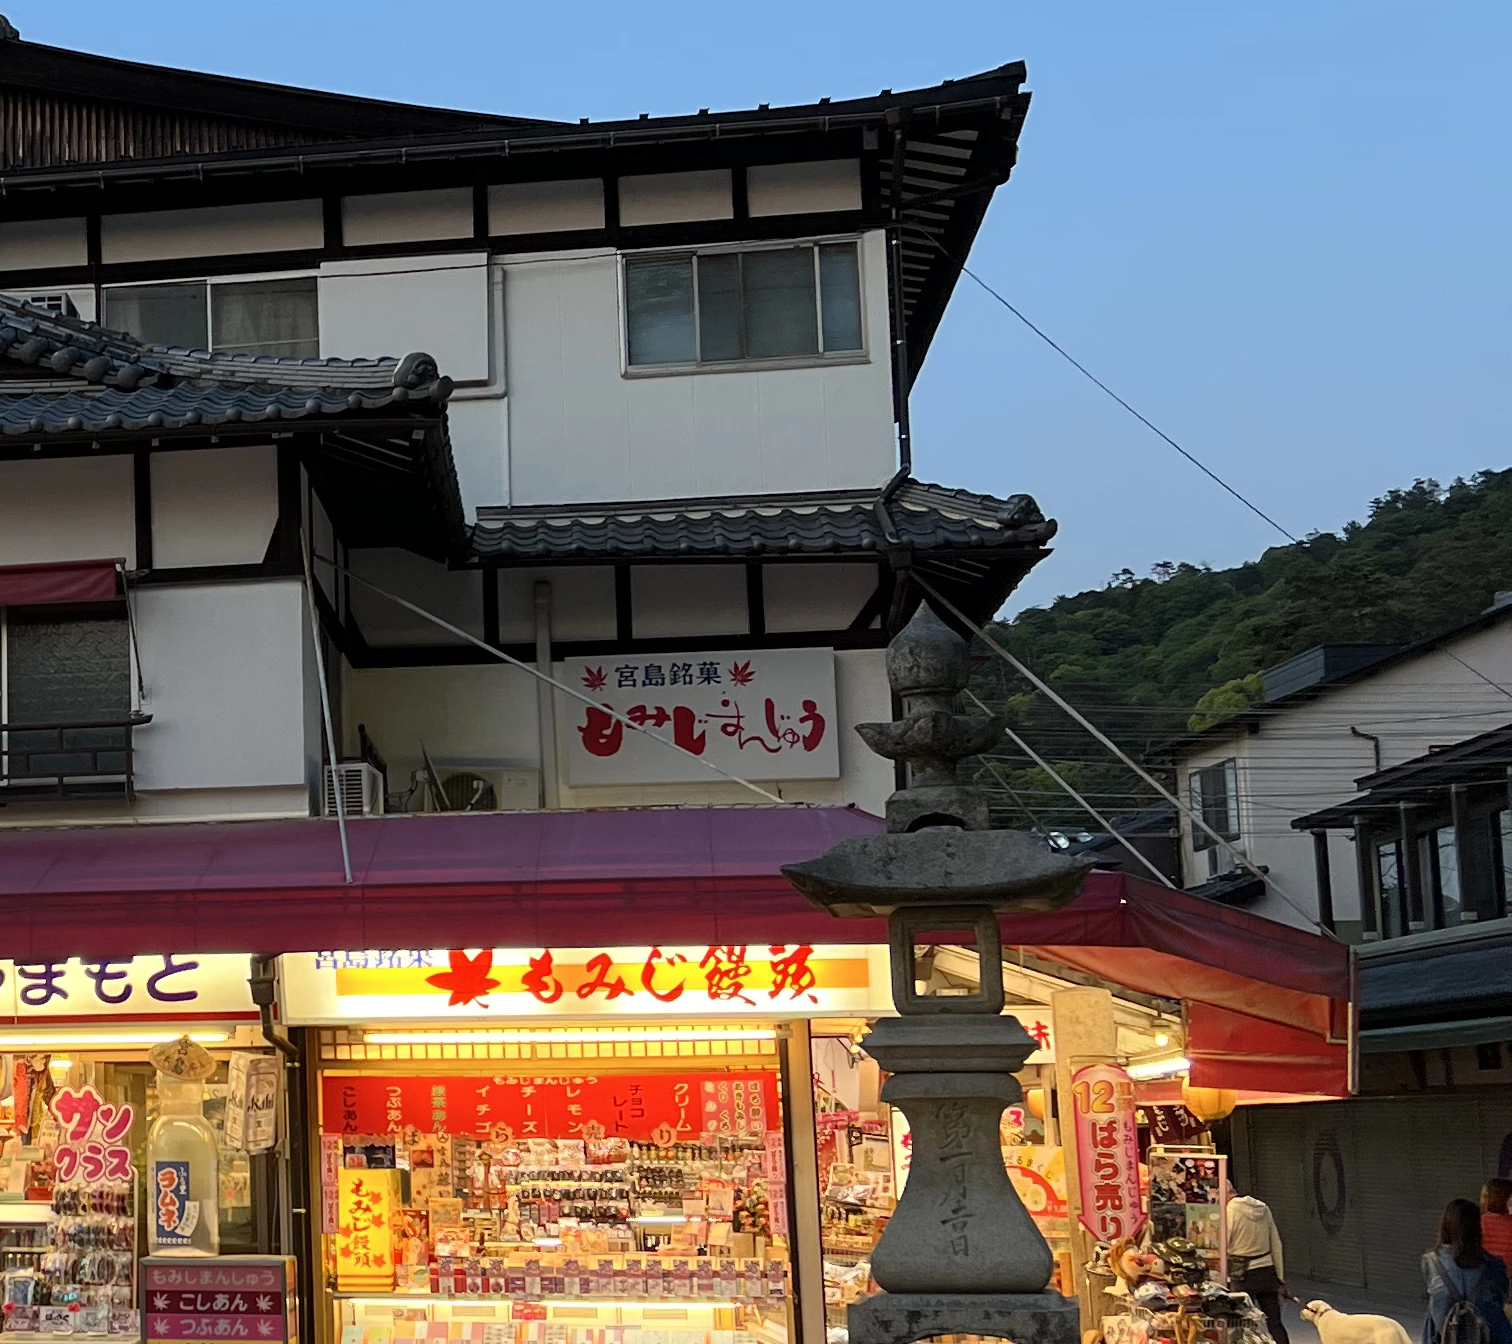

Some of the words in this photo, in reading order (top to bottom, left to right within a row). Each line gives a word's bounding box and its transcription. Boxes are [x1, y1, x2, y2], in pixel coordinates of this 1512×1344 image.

[615, 661, 722, 689] 宮島銘菓
[577, 698, 826, 757] もみじまんじゅう
[522, 945, 819, 1006] もみじ饅頭
[343, 1085, 358, 1133] こしあん
[385, 1085, 402, 1133] つぶあん
[475, 1085, 491, 1134] イチゴ
[521, 1085, 538, 1134] チーズ
[566, 1085, 583, 1133] レモン
[613, 1096, 628, 1133] レート
[629, 1084, 645, 1119] チョコ
[673, 1083, 692, 1132] クリーム
[1073, 1080, 1115, 1114] 12
[1090, 1118, 1125, 1242] ばら売り
[1123, 1121, 1139, 1225] もみじまんじゅう
[158, 1167, 179, 1231] ラムネ
[348, 1178, 373, 1269] もみじ饅頭
[179, 1292, 248, 1312] こしあん
[179, 1318, 249, 1337] つぶあん
